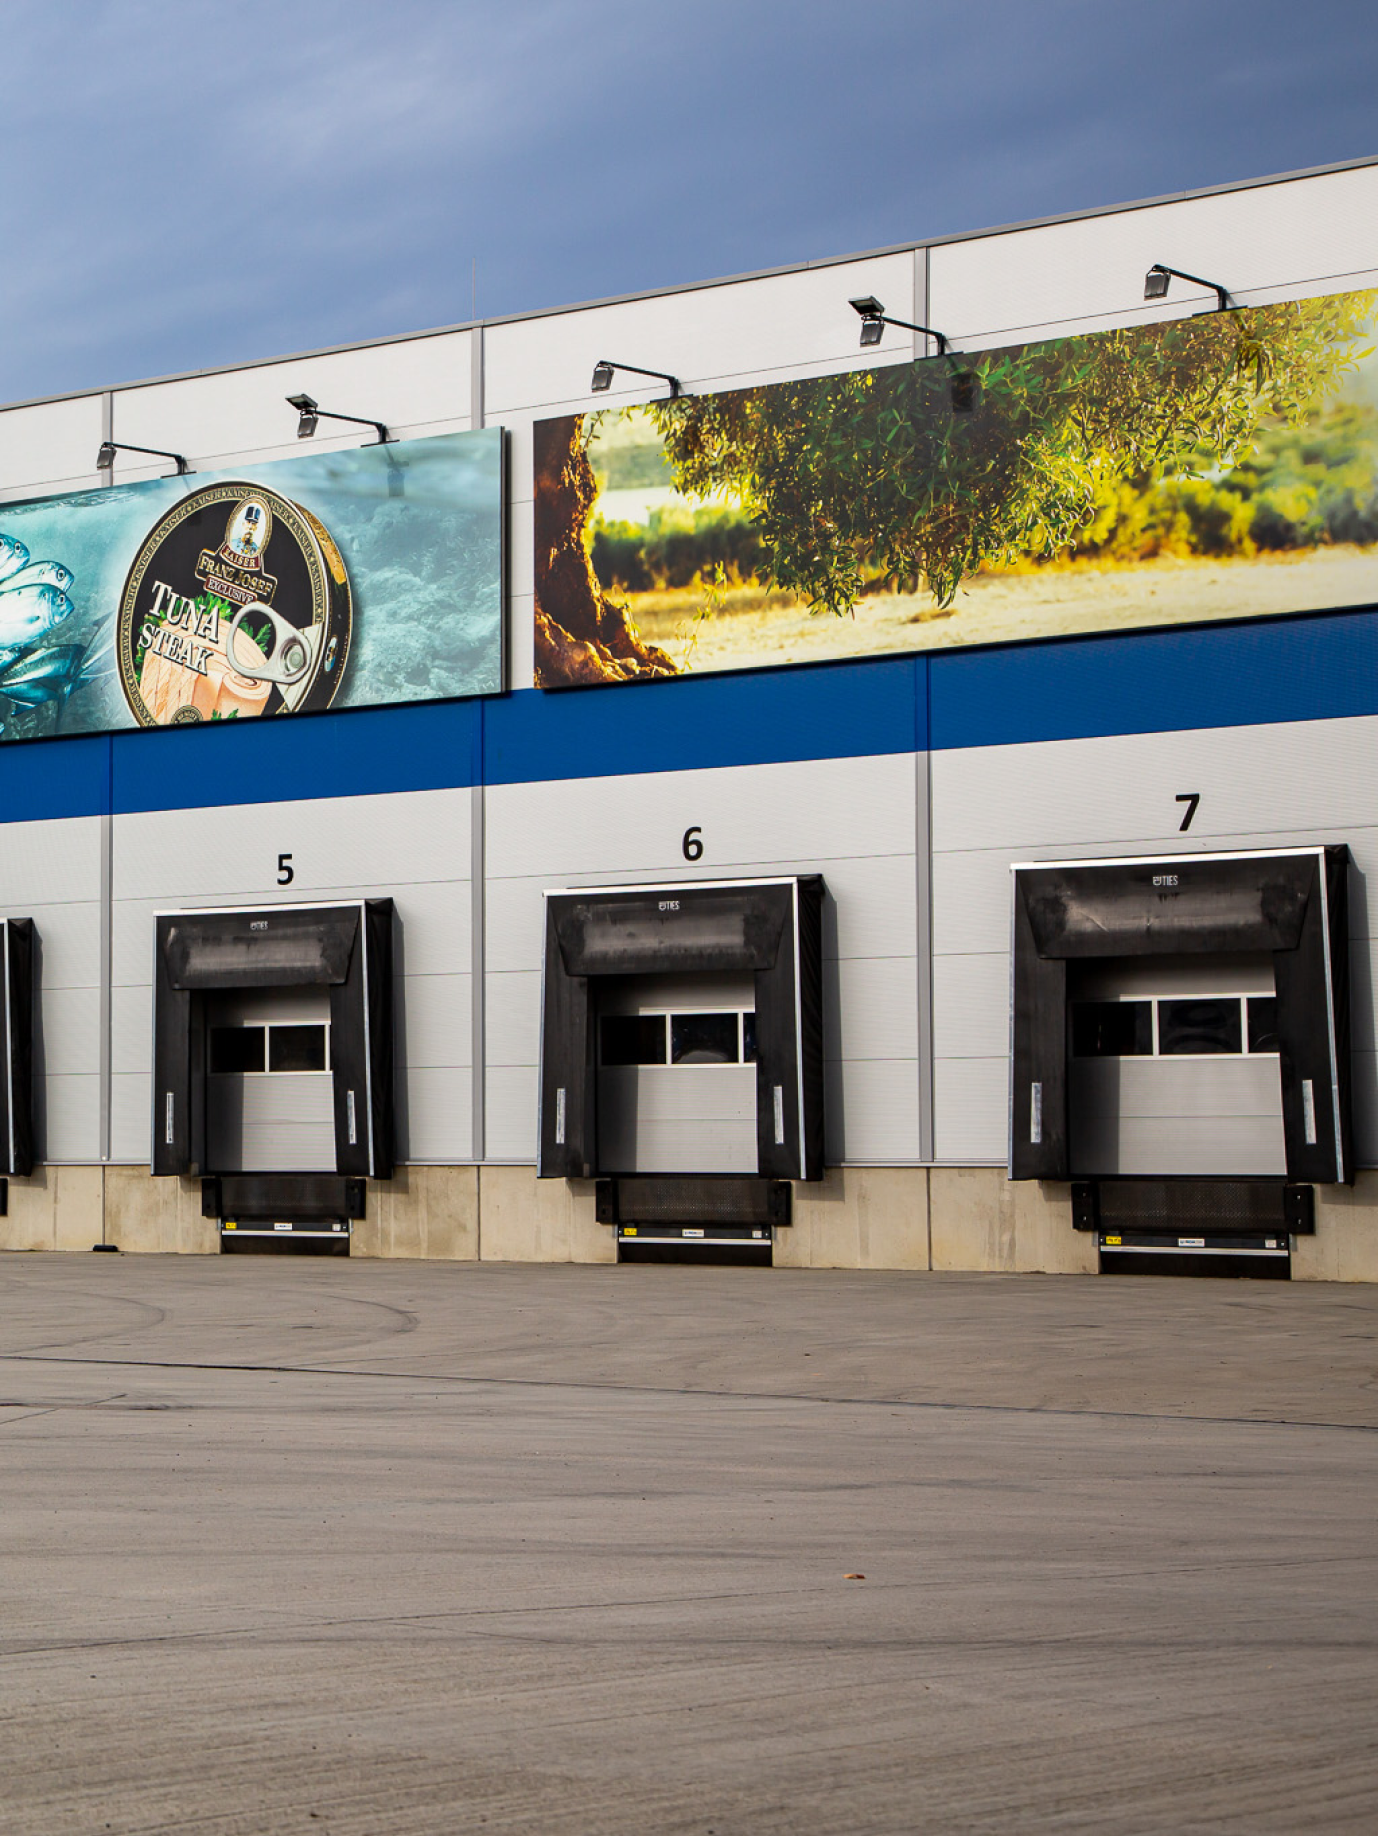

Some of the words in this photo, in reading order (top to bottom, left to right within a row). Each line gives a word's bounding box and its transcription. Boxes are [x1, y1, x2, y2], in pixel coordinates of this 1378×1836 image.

[199, 554, 235, 582] FRANZ
[234, 570, 273, 596] JOSEF
[223, 549, 256, 568] KAISER
[151, 580, 219, 644] TUNA
[138, 621, 214, 675] STEAK
[1175, 793, 1200, 832] 7
[682, 826, 704, 862] 6
[276, 853, 294, 886] 5
